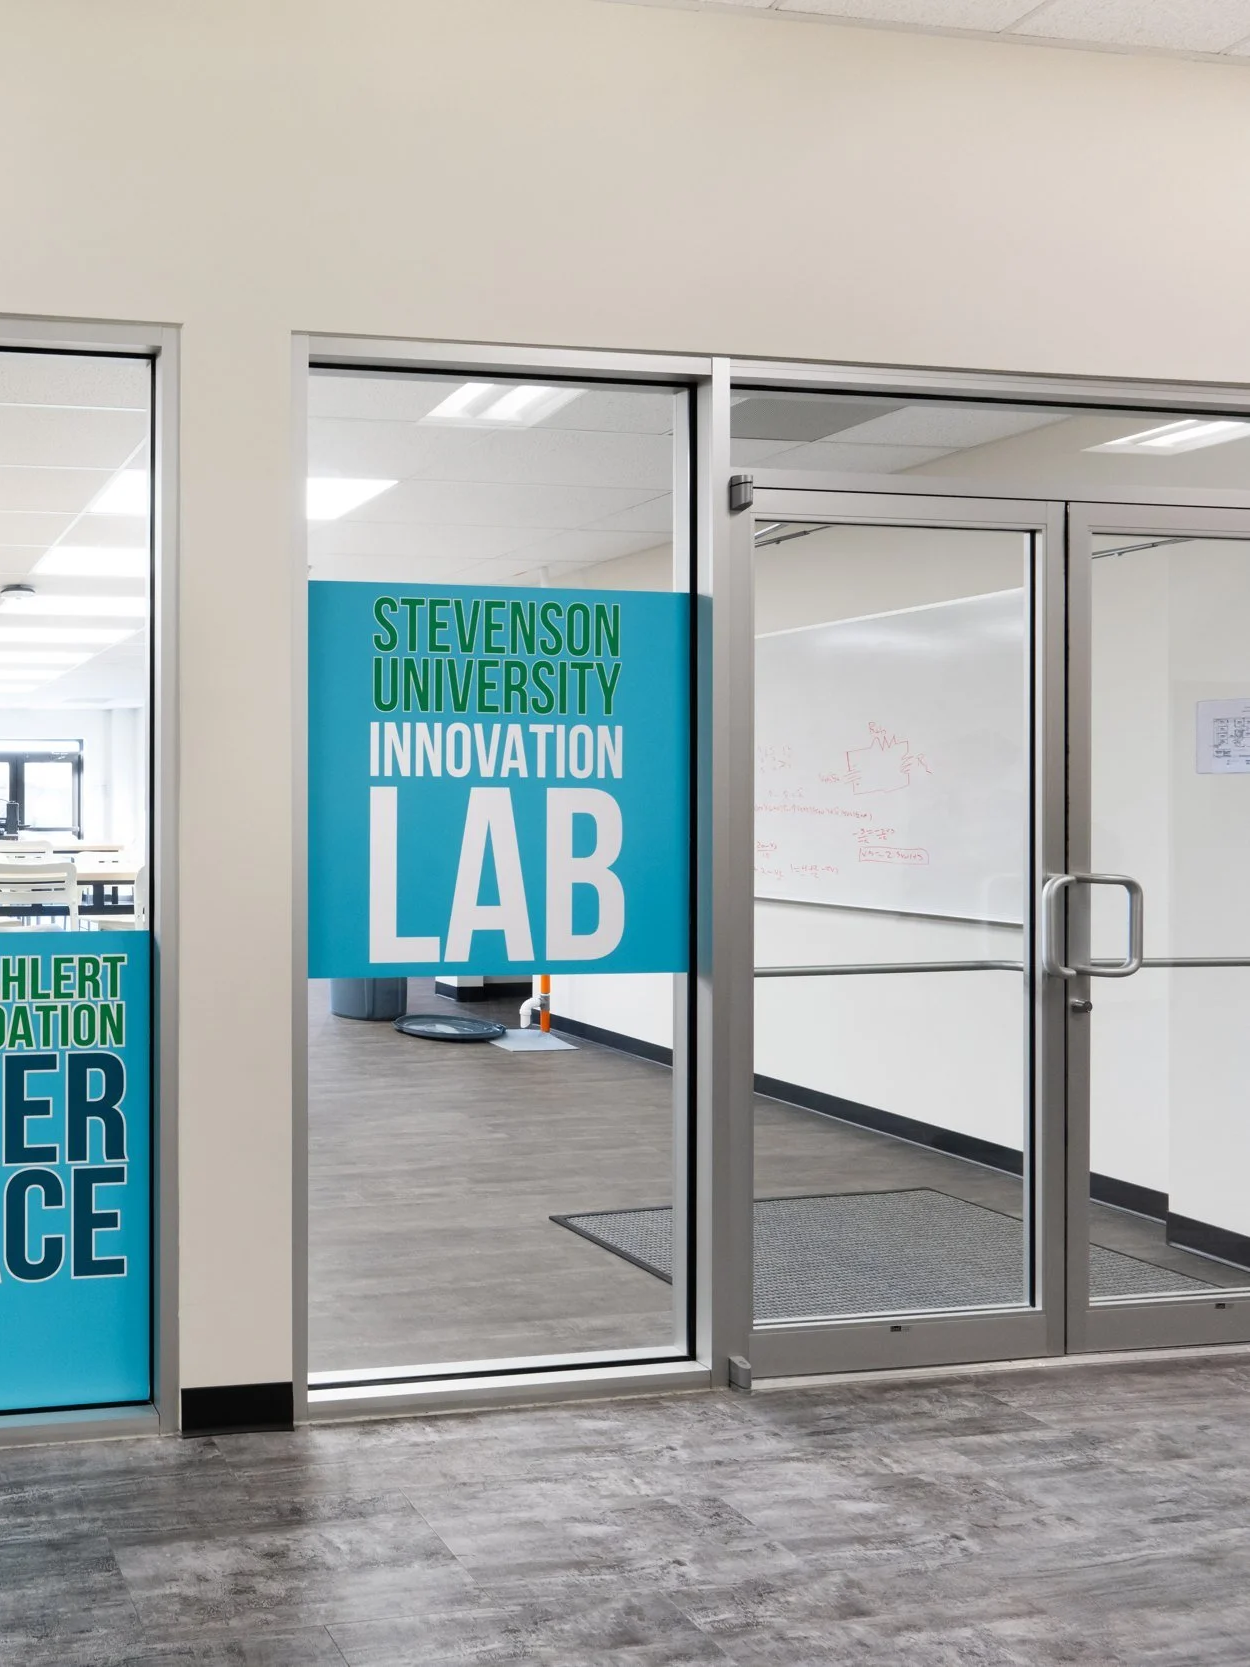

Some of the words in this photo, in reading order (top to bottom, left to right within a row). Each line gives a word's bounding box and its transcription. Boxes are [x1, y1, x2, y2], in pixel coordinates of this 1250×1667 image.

[372, 596, 621, 657] STEVENSON
[372, 656, 622, 716] UNIVERSITY
[369, 721, 623, 779] INNOVATION
[369, 786, 625, 964] LAB
